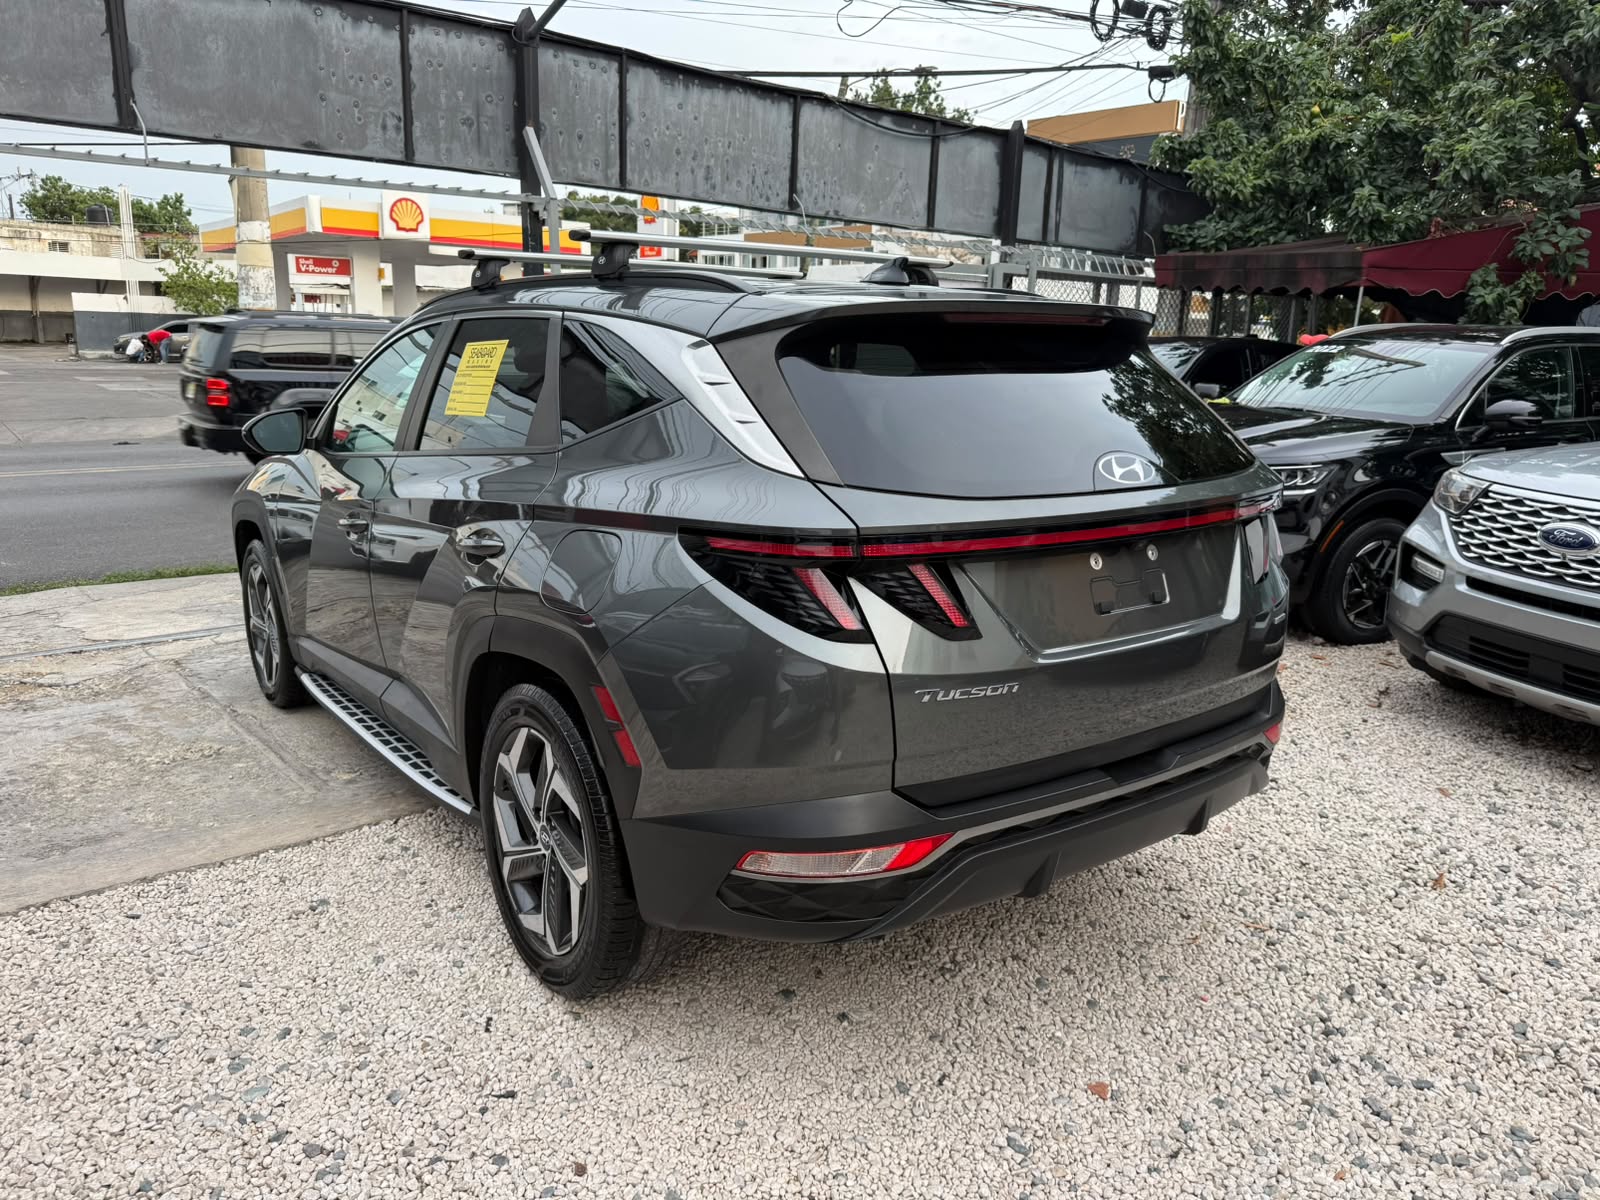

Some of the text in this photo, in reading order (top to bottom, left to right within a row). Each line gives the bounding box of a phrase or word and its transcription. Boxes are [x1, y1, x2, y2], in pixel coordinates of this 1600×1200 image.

[299, 264, 338, 274] V-Power
[1549, 528, 1583, 545] Ford
[914, 682, 1020, 703] TUCSON
